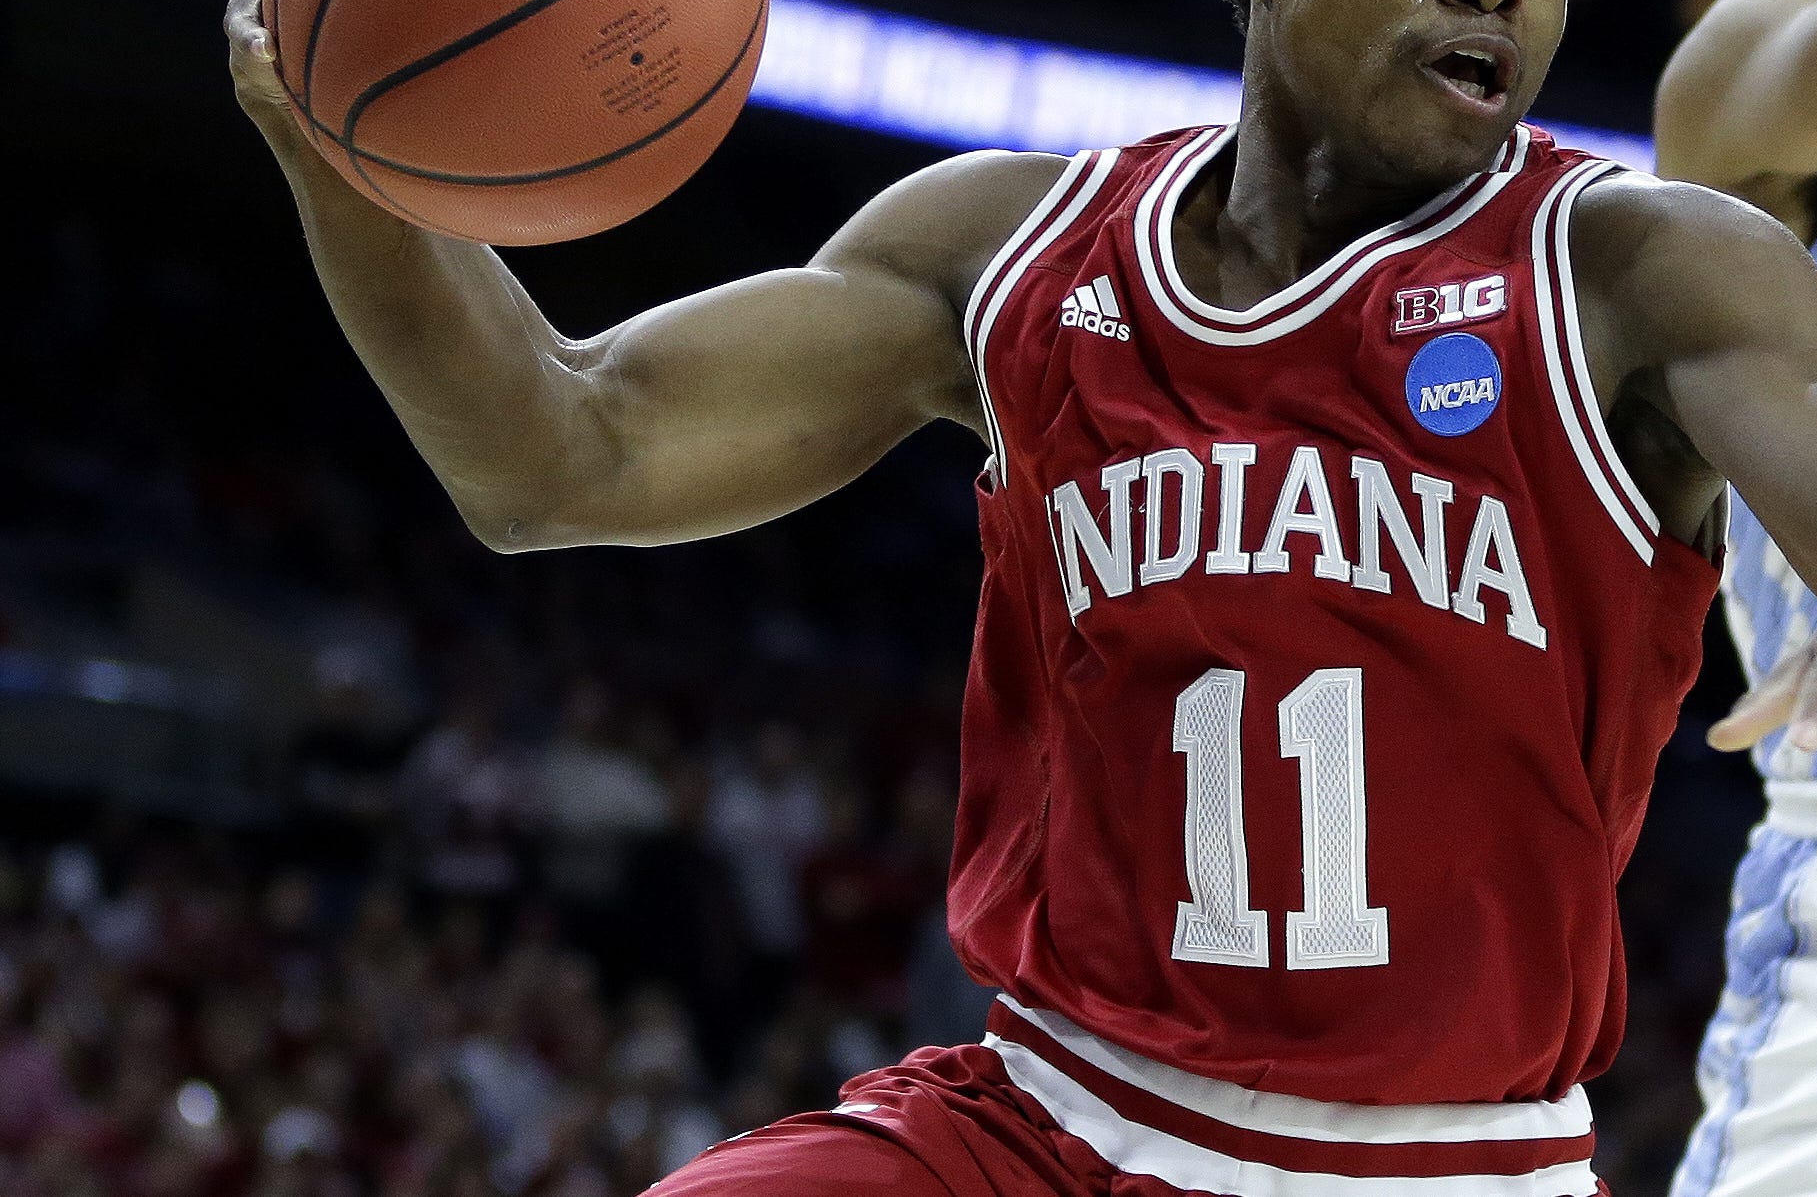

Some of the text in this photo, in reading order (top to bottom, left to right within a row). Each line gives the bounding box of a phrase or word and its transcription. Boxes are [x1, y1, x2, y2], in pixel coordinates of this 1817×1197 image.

[1419, 376, 1496, 413] NCAA
[1046, 441, 1548, 652] NDIANA
[1170, 667, 1390, 971] 11
